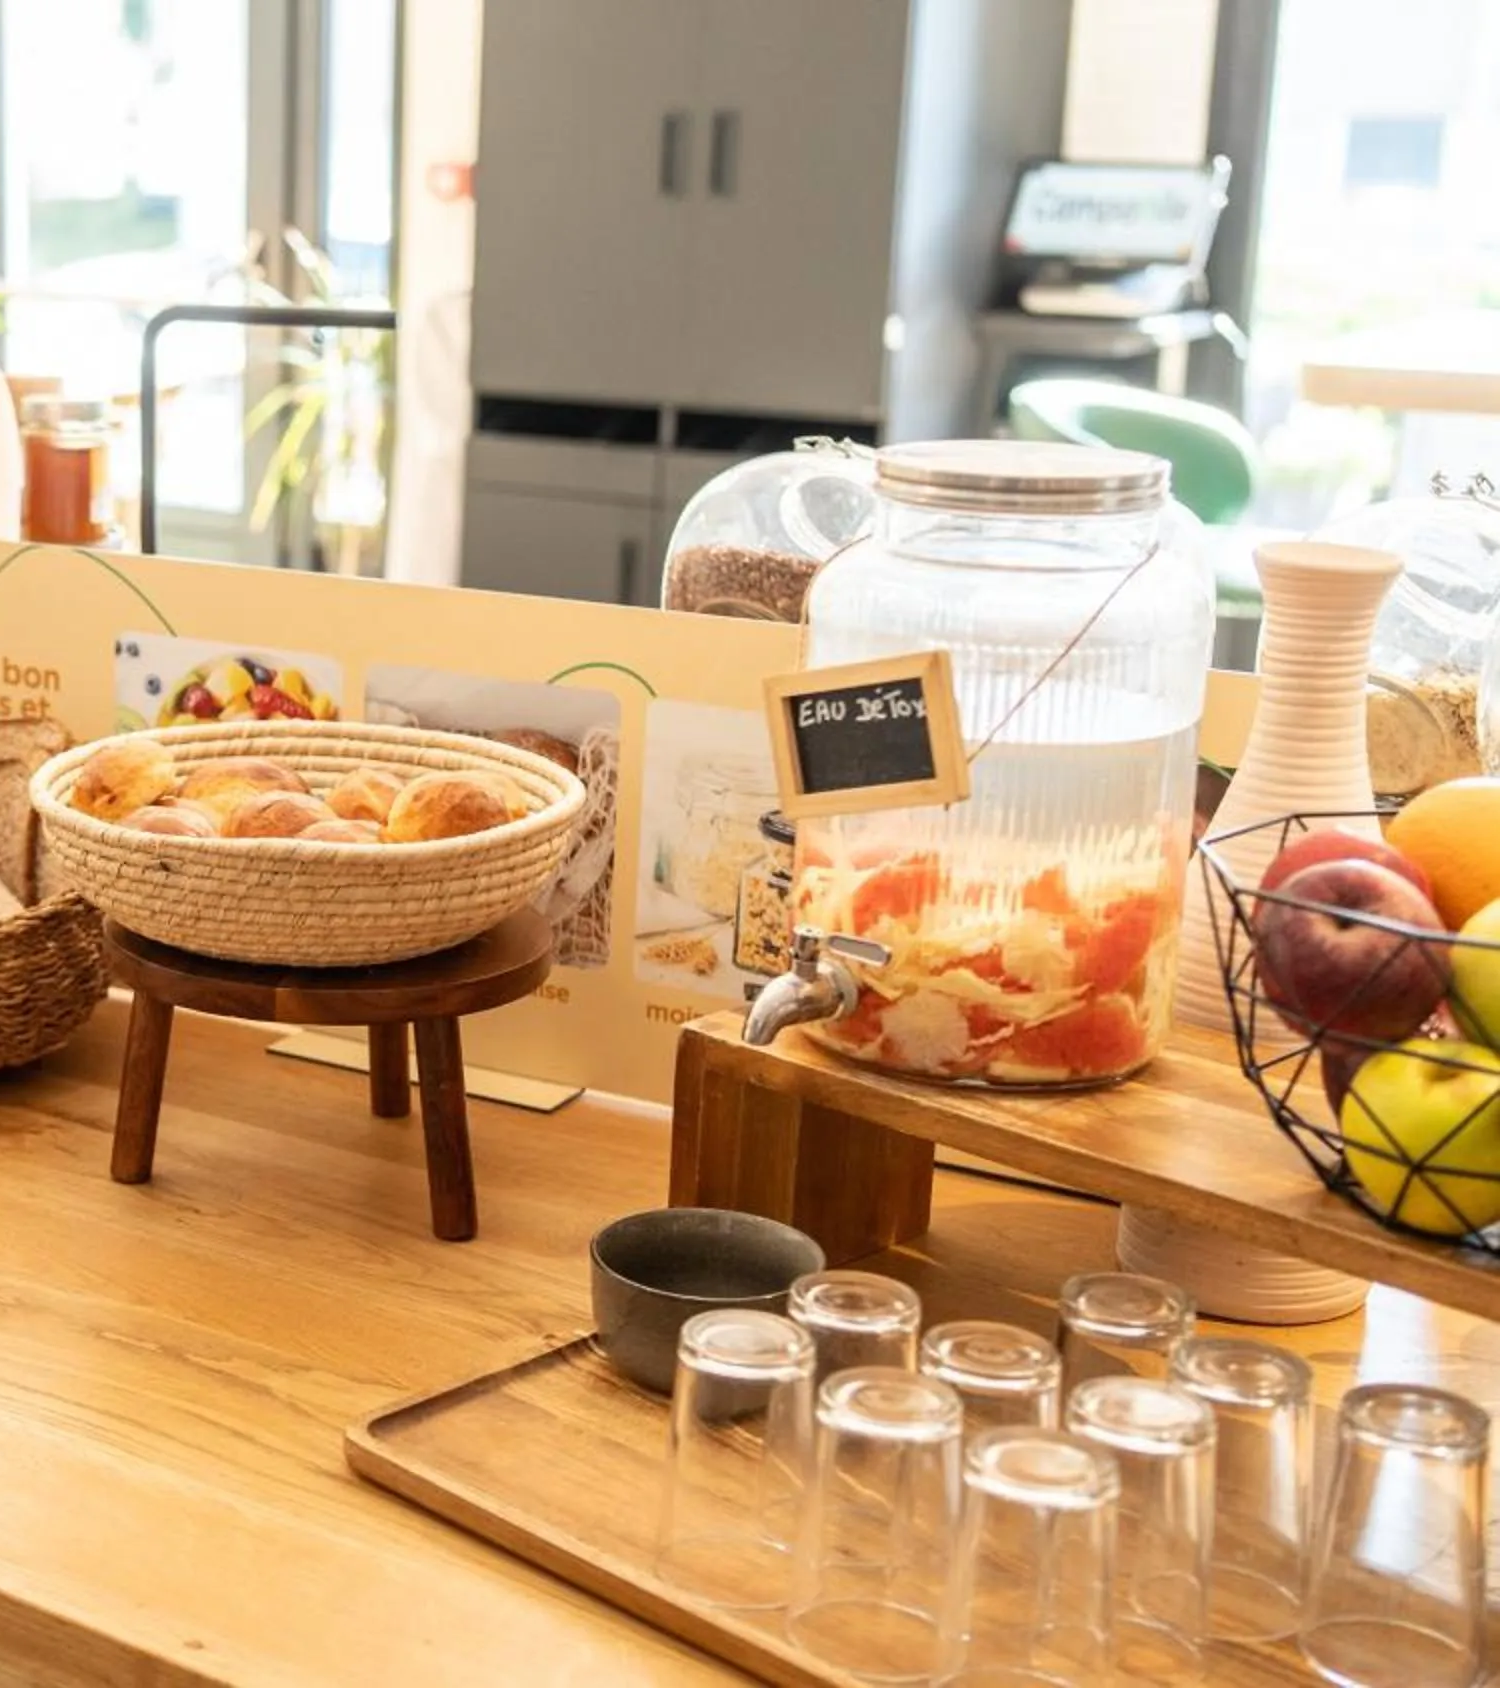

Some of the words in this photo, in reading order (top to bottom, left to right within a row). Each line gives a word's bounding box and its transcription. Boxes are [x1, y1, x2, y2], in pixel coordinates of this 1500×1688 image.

[2, 657, 60, 692] bon
[19, 697, 51, 719] et
[798, 698, 847, 728] EAU
